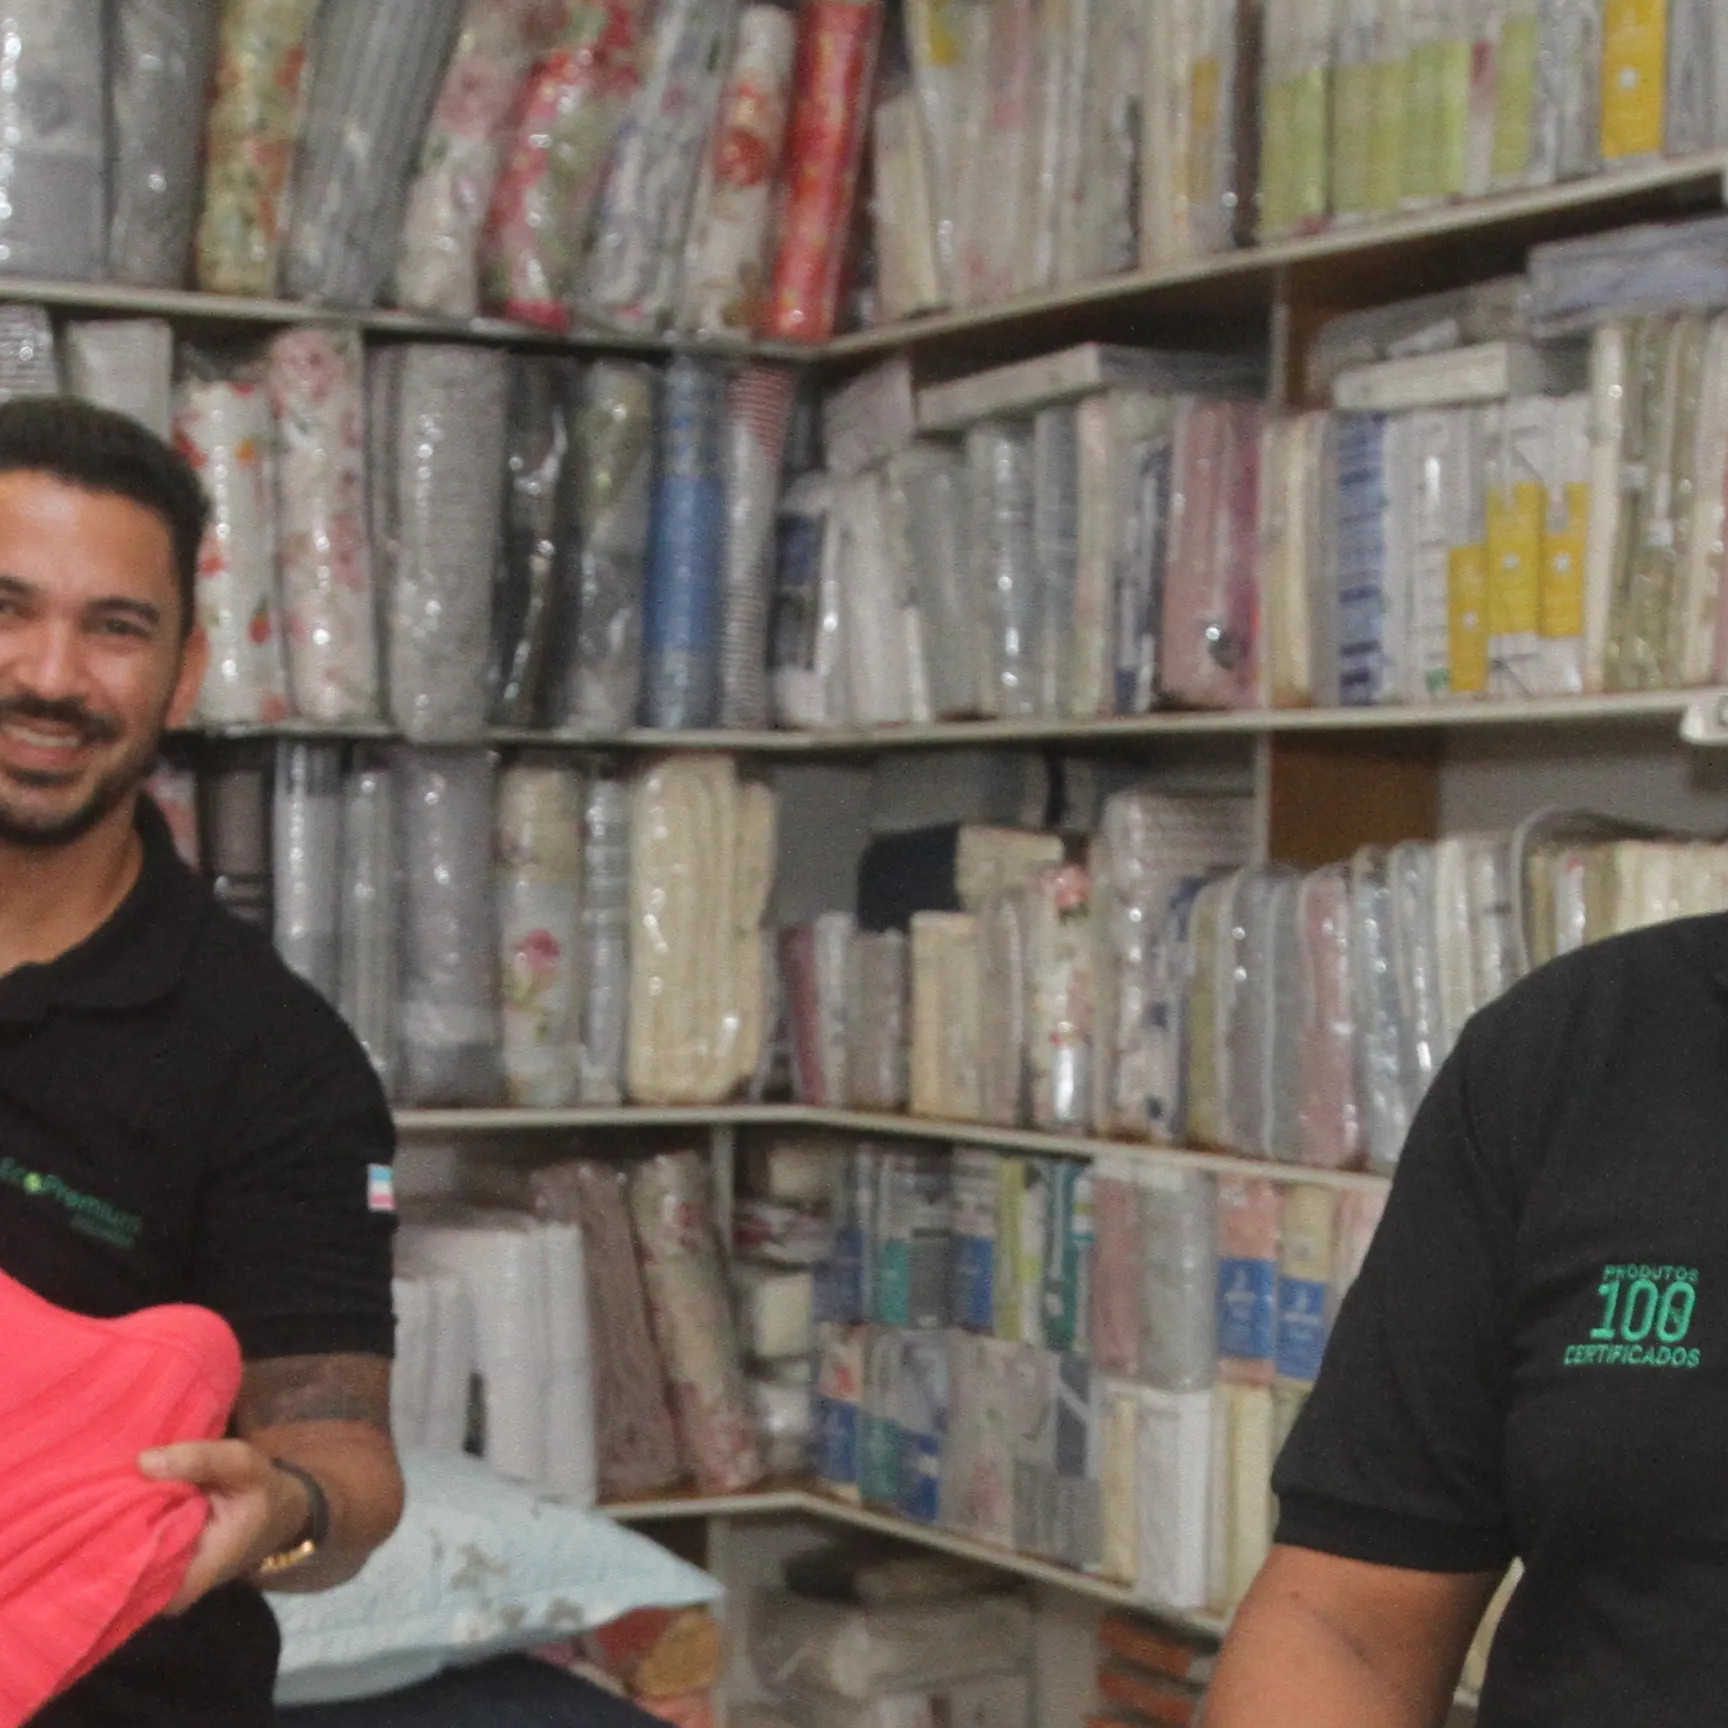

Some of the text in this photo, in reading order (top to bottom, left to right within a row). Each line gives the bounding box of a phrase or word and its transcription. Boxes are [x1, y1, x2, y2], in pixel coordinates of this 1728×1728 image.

[1602, 1263, 1699, 1282] PRODUTOS
[1589, 1279, 1696, 1343] 100
[1563, 1344, 1701, 1368] CERTIFICADOS
